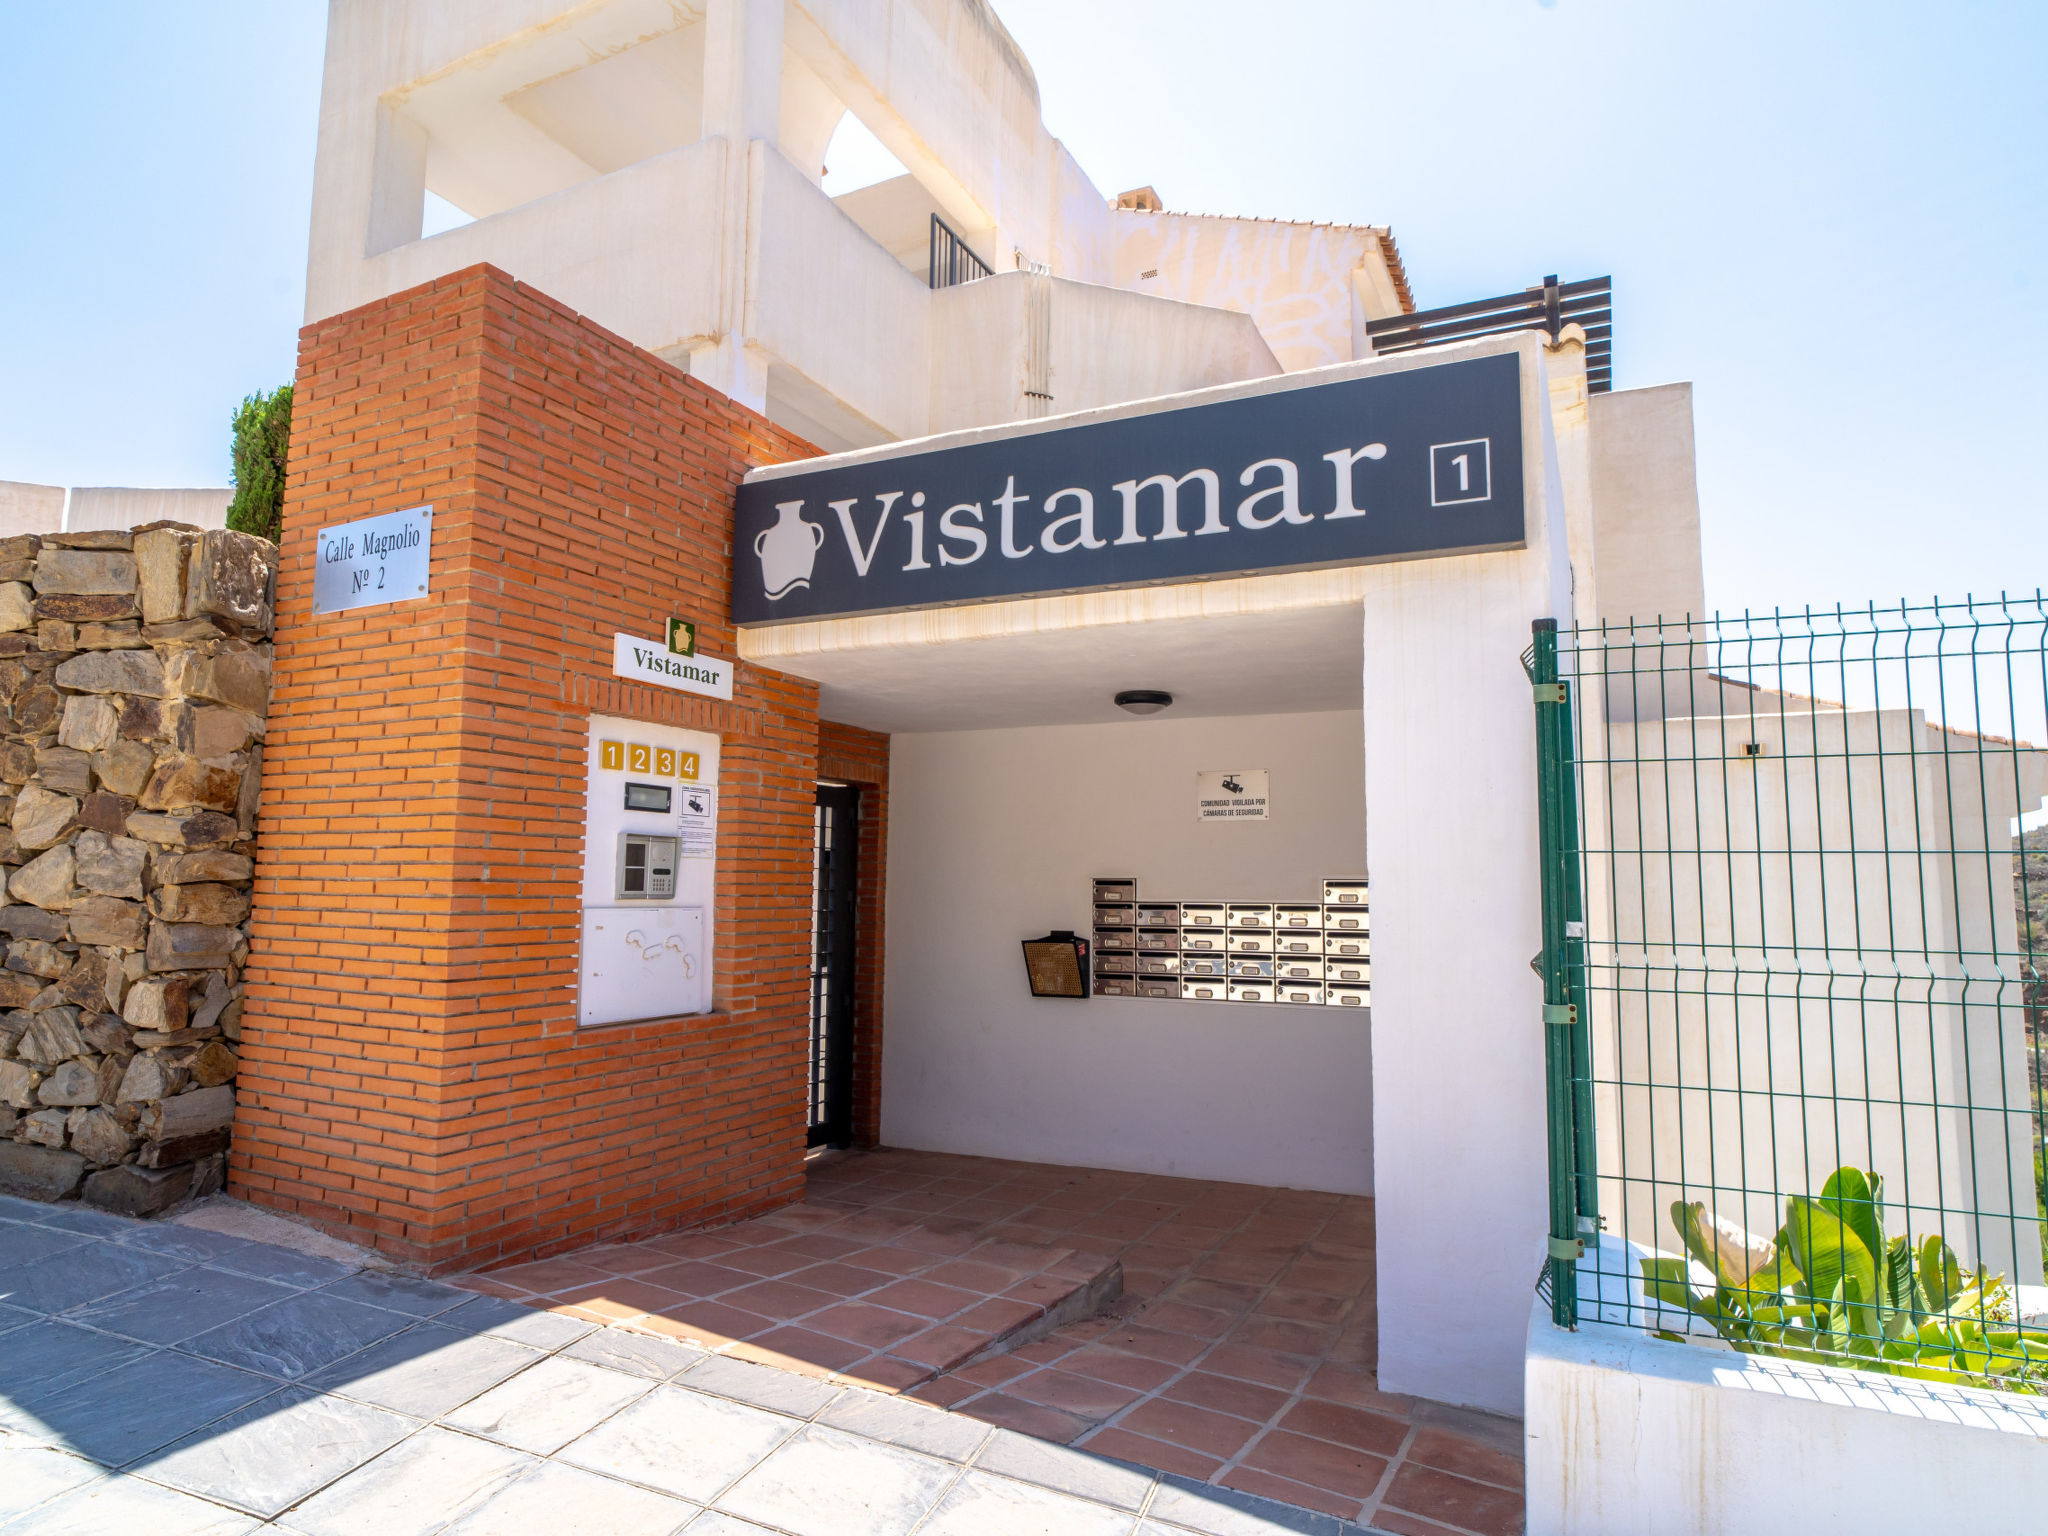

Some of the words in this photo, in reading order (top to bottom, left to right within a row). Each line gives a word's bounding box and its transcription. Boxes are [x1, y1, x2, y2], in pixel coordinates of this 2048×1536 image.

[828, 442, 1388, 577] Vistamar
[1451, 454, 1469, 491] 1
[325, 536, 355, 563] Calle
[361, 523, 420, 560] Magnolio
[352, 568, 369, 594] Nº
[377, 566, 385, 590] 2
[633, 647, 720, 685] Vistamar
[608, 746, 616, 767] 1
[635, 749, 646, 769] 2
[661, 753, 672, 773] 3
[684, 757, 695, 776] 4
[1201, 799, 1230, 807] COMUNIDAD
[1231, 798, 1255, 806] VIGILADA
[1235, 808, 1264, 816] SEGURIDAD
